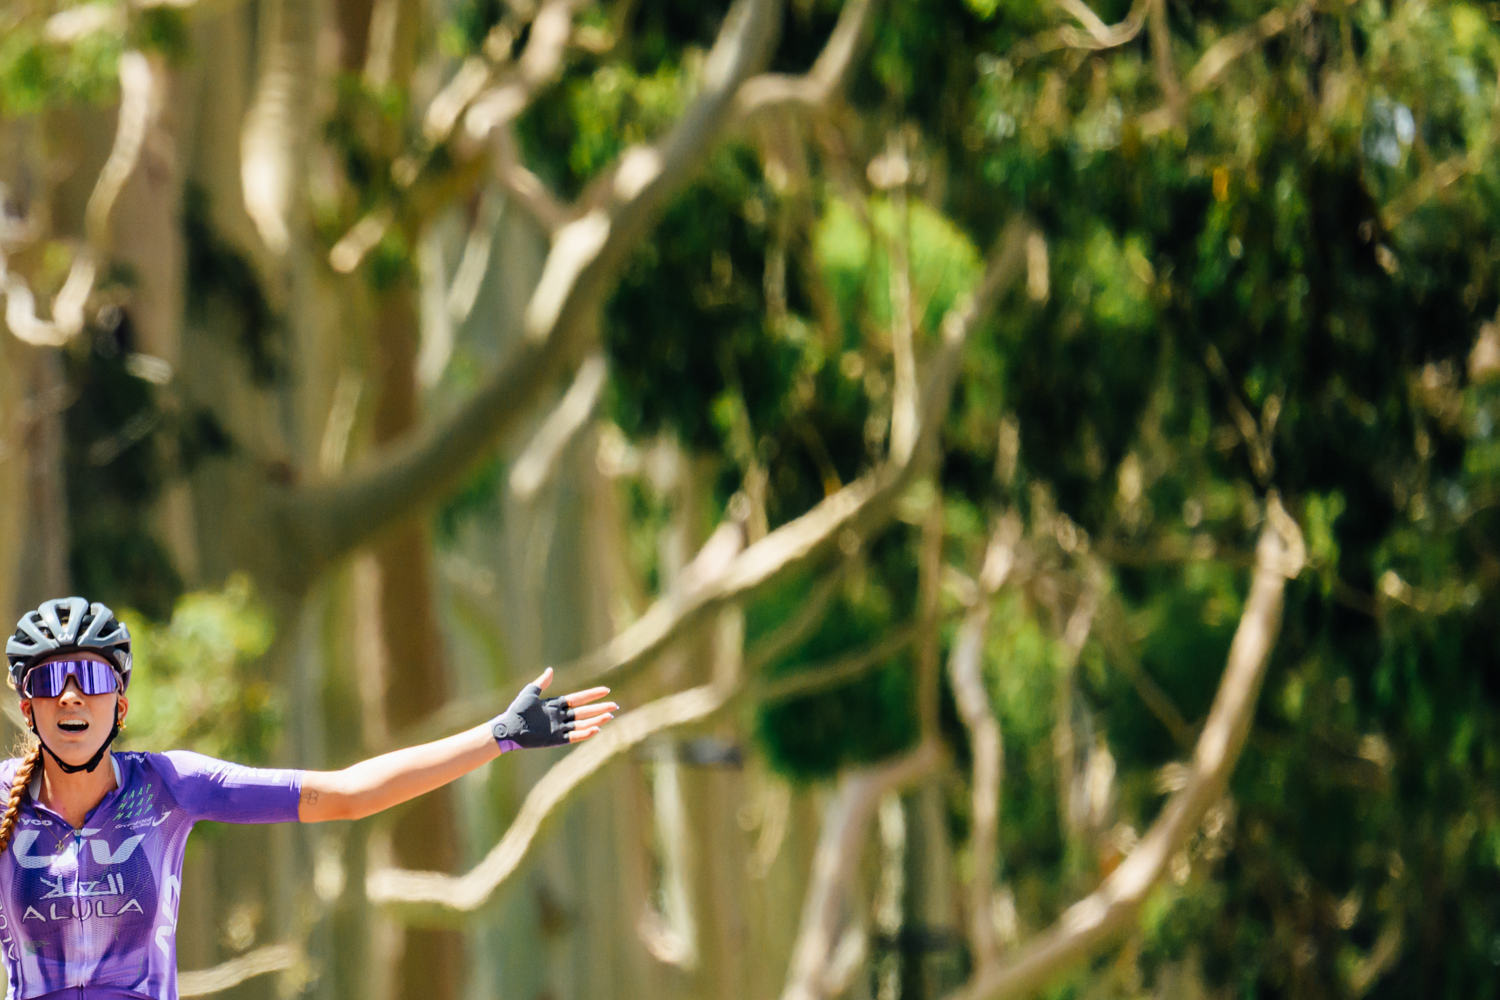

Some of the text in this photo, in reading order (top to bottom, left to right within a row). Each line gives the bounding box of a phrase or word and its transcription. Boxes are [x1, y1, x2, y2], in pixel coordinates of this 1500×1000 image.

[117, 793, 154, 811] MAAP
[113, 804, 153, 821] MAAP
[22, 898, 145, 923] ALULA
